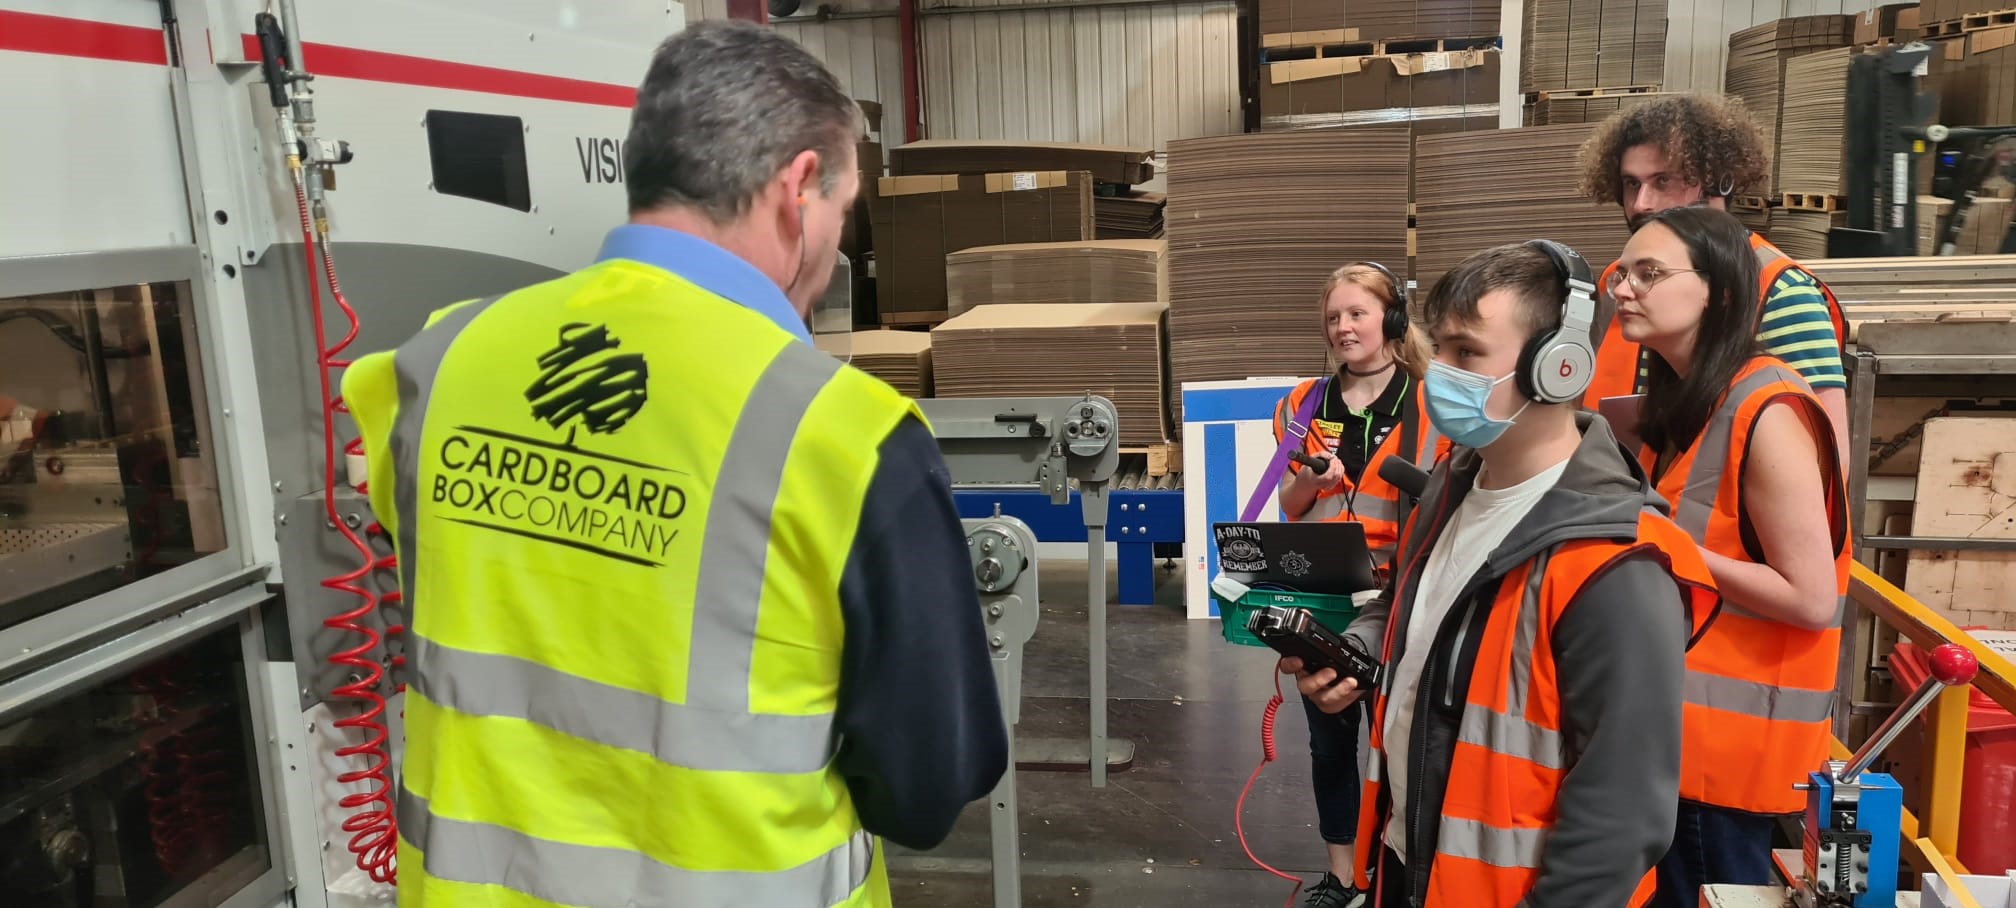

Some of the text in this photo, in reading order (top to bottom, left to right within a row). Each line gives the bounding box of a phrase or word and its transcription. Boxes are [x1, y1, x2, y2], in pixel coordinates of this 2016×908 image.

[440, 435, 687, 520] CARDBOARD
[1222, 559, 1268, 571] REMEMBER
[1274, 594, 1294, 602] IFCO
